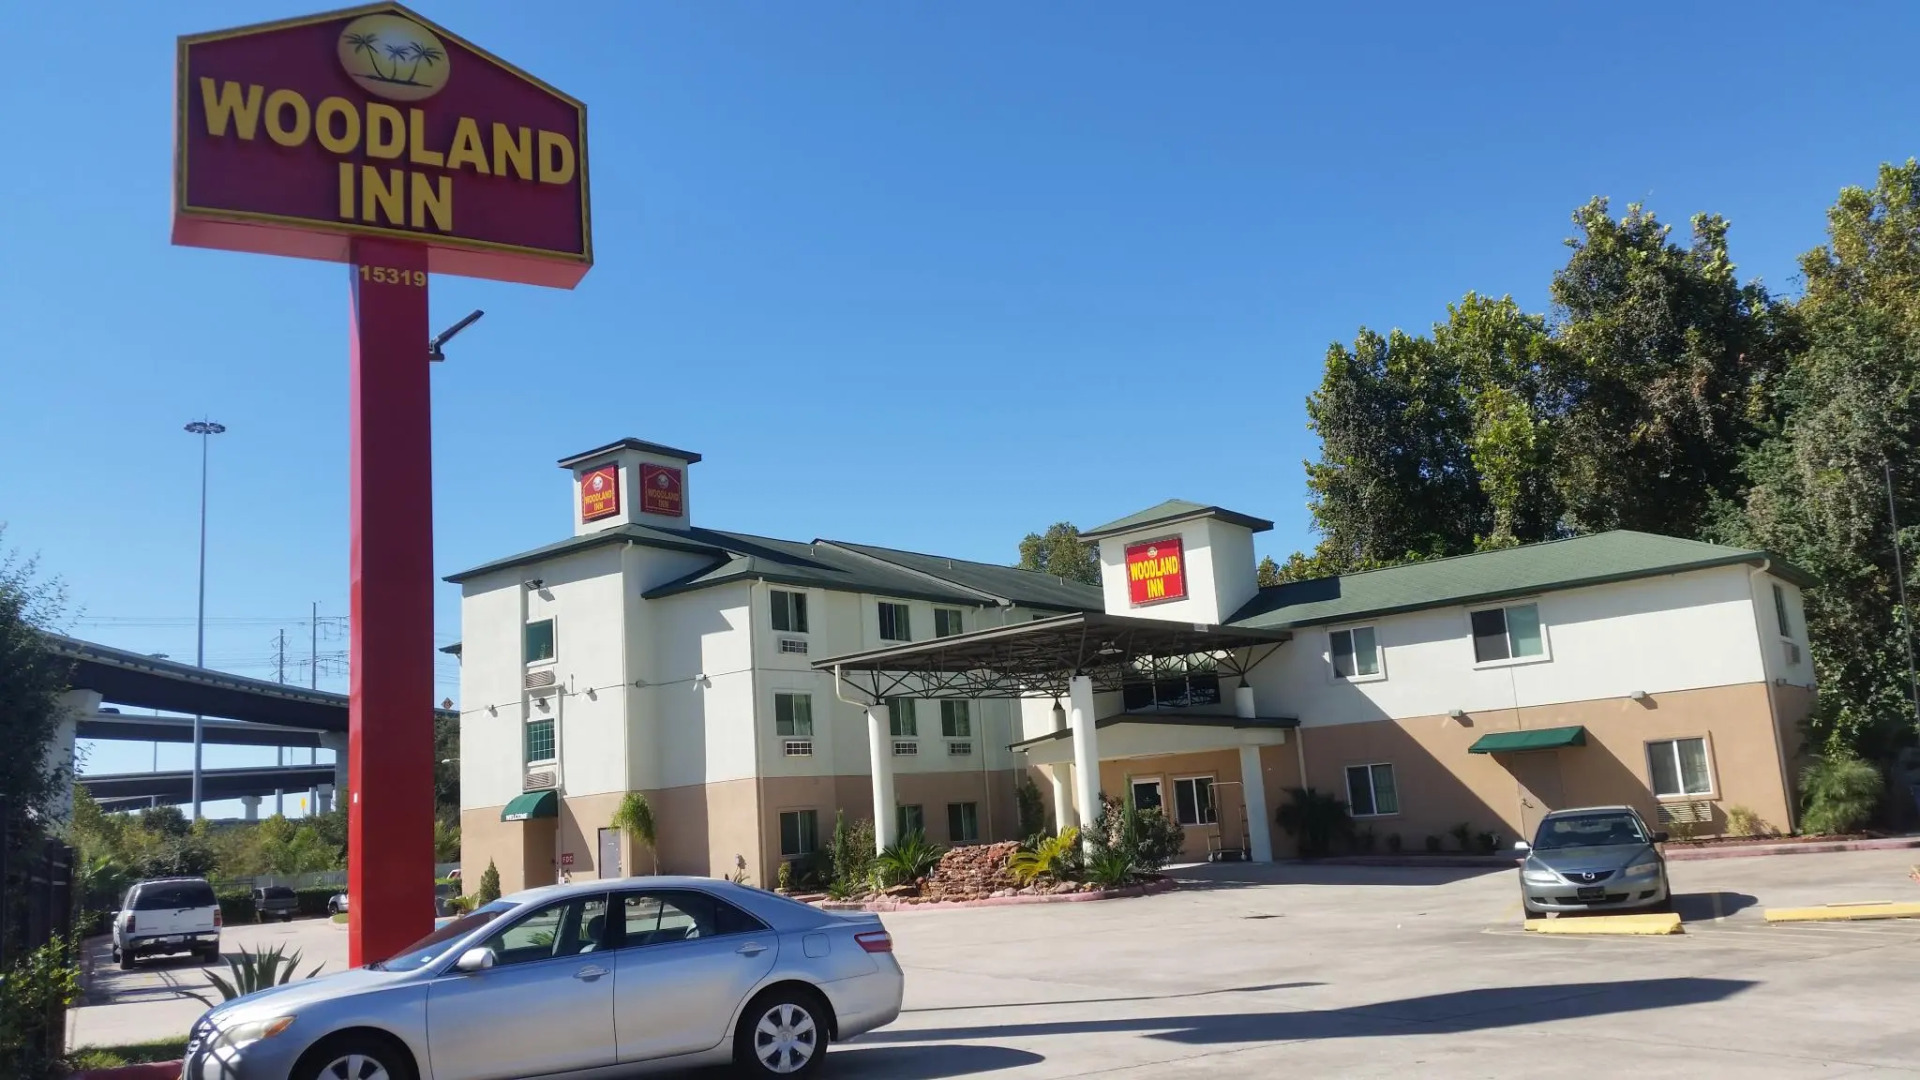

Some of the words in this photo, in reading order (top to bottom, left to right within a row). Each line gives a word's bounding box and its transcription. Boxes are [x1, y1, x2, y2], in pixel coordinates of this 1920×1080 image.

[200, 77, 576, 185] WOODLAND
[338, 162, 453, 231] INN
[360, 264, 427, 287] 15319
[584, 489, 613, 505] WOODLAND
[593, 501, 604, 511] INN
[1130, 556, 1178, 581] WOODLAND
[1147, 578, 1164, 598] INN
